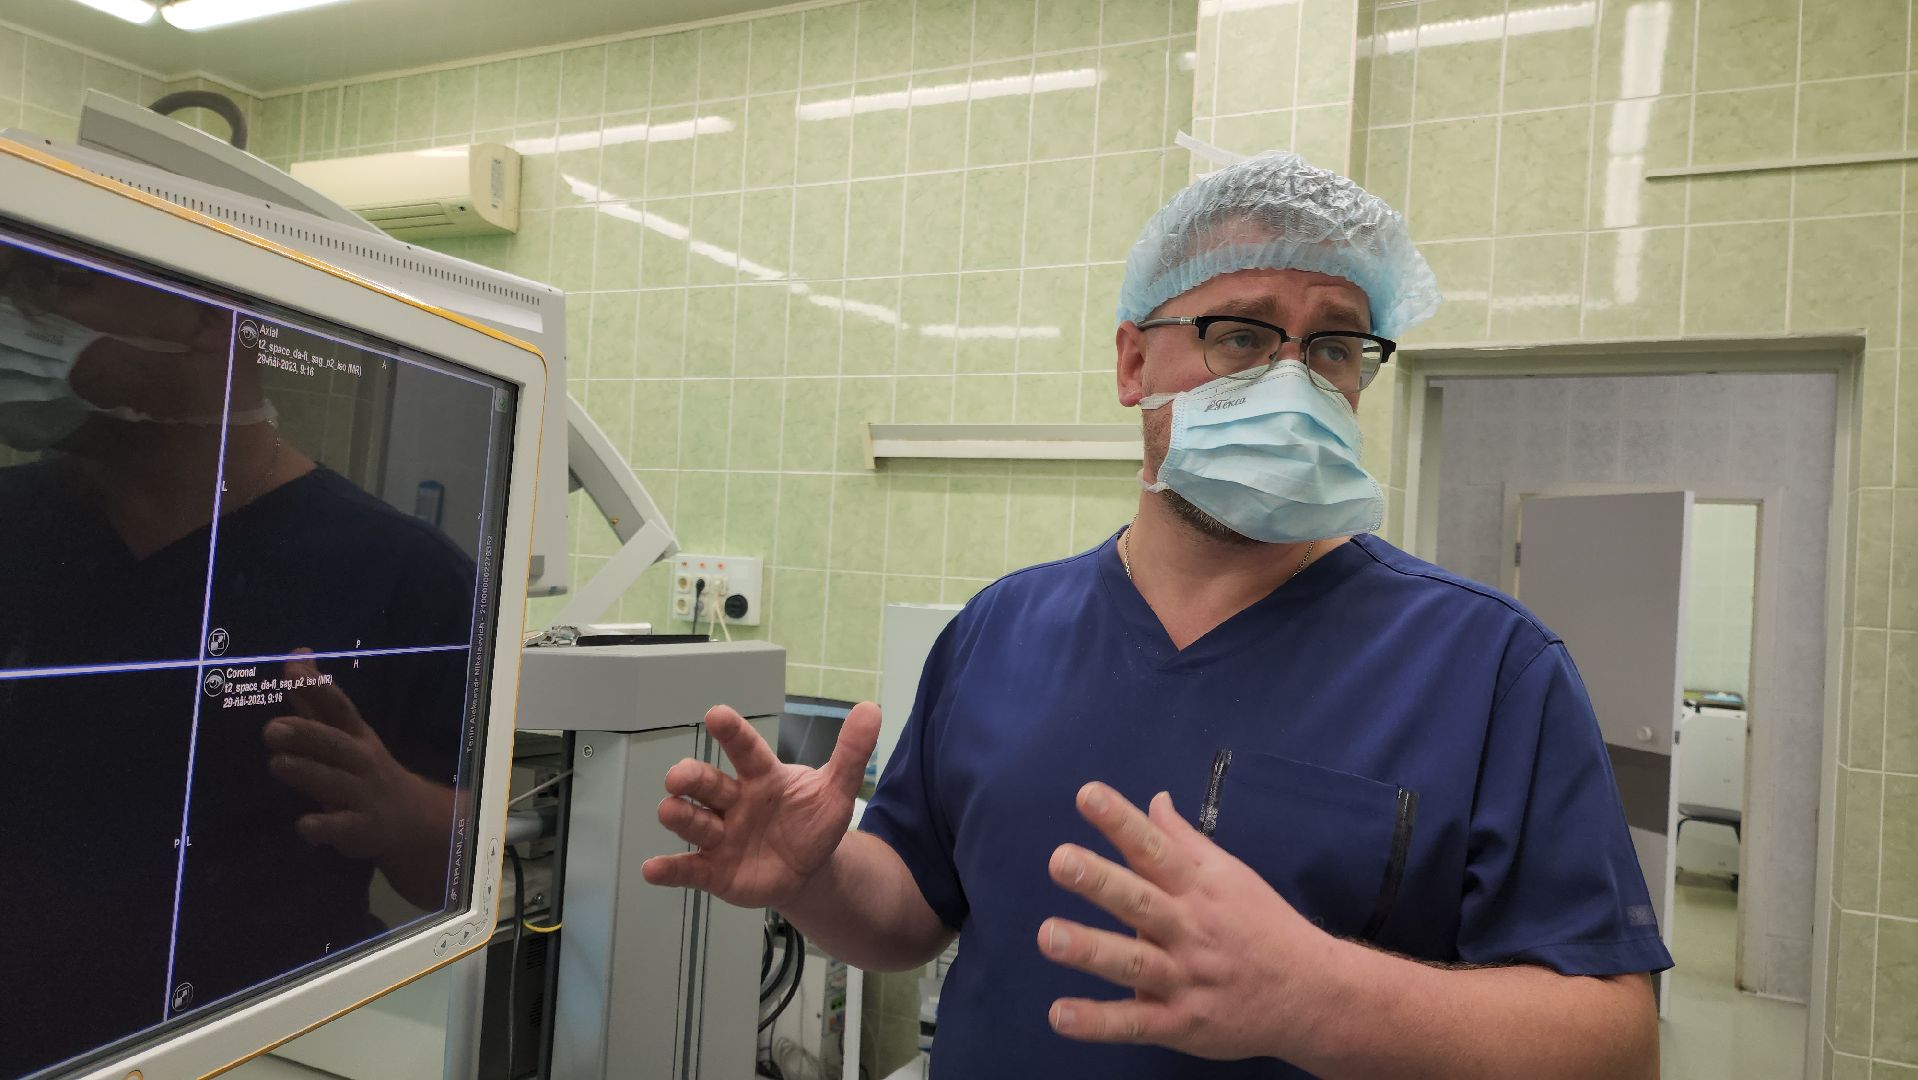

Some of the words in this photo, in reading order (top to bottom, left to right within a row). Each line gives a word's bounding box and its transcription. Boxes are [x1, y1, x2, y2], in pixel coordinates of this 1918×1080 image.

[259, 324, 279, 338] Axial
[300, 366, 315, 377] 9:16
[348, 364, 362, 377] (MR)
[222, 480, 228, 491] L
[356, 639, 361, 648] P
[353, 659, 359, 669] H
[226, 667, 256, 679] Coronal
[318, 674, 333, 686] (MR)
[268, 692, 283, 704] 9:16
[174, 838, 180, 849] P
[186, 835, 192, 847] L
[325, 942, 331, 954] F
